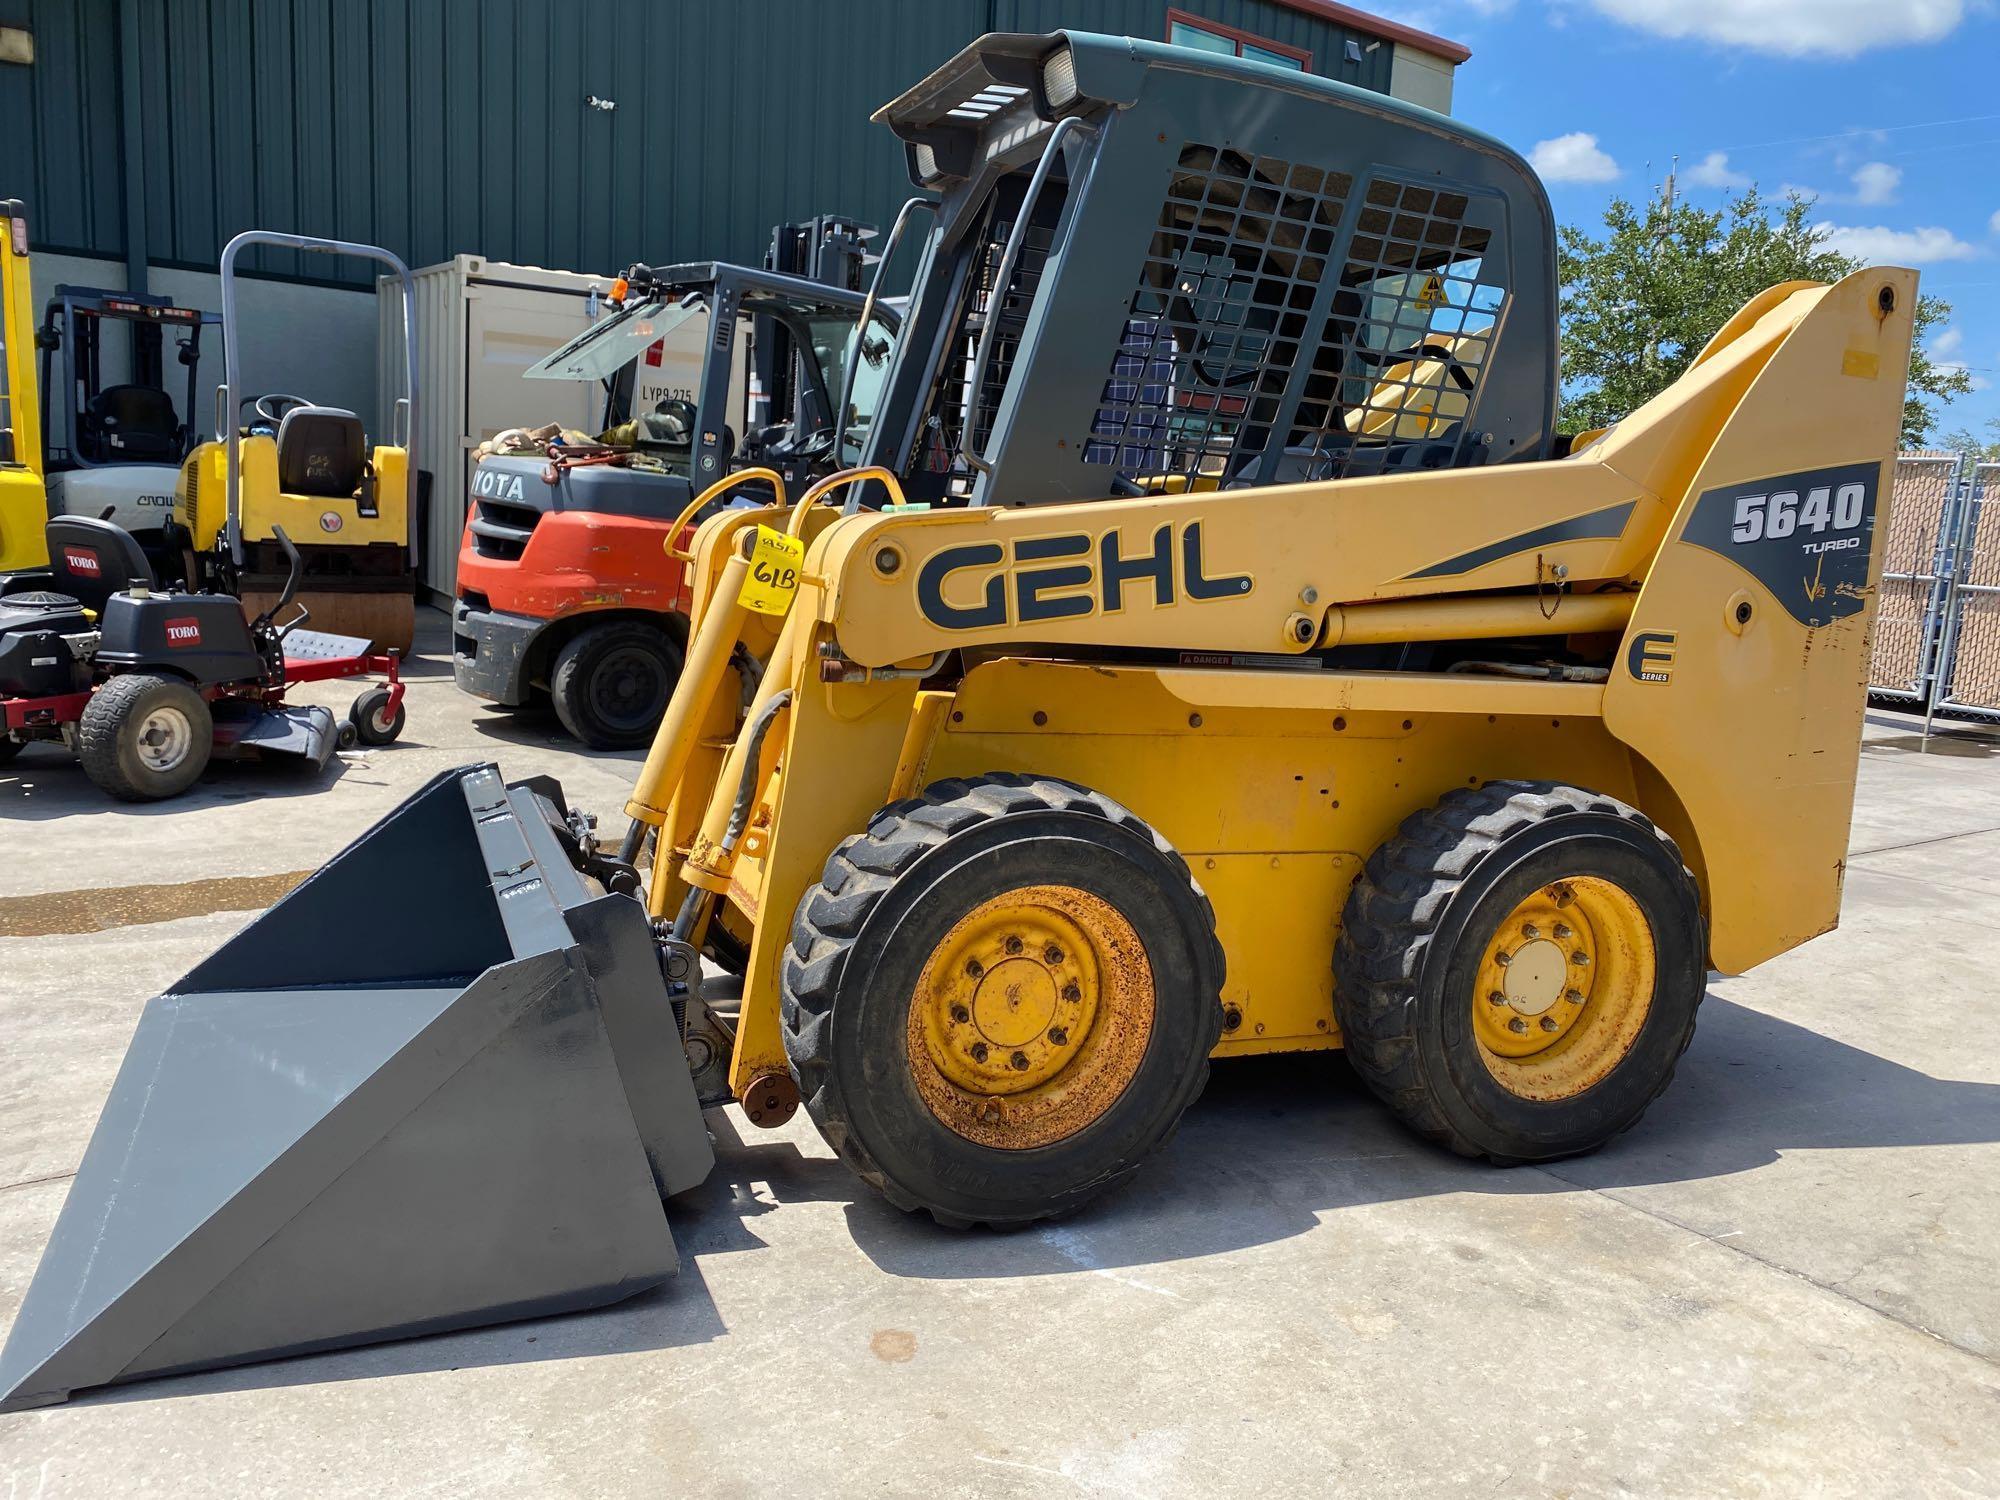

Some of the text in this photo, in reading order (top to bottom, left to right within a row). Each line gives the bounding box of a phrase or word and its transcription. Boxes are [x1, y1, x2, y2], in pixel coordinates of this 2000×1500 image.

[471, 470, 523, 500] YOTA
[1732, 482, 1865, 543] 5640
[1802, 537, 1860, 555] TURBO
[67, 555, 98, 569] TORO
[917, 521, 1254, 630] GEHL
[168, 626, 199, 640] TORO
[1193, 656, 1229, 665] DANGER
[1628, 633, 1675, 682] E
[1641, 673, 1667, 681] SERIES
